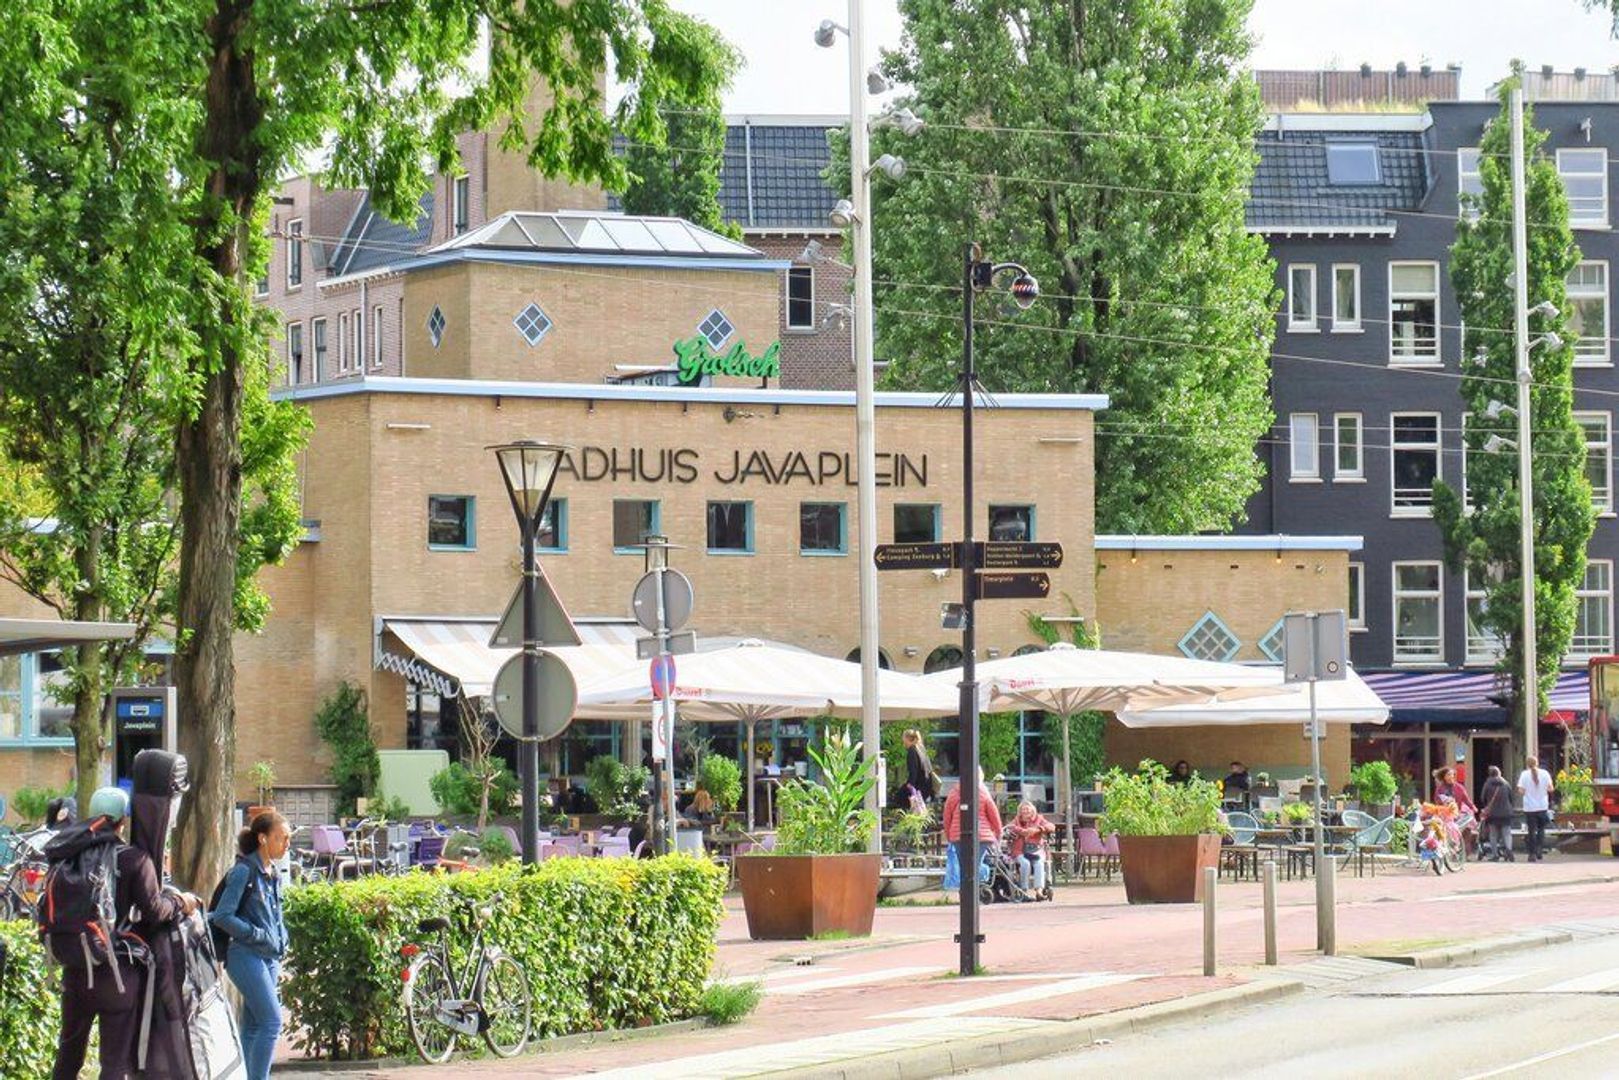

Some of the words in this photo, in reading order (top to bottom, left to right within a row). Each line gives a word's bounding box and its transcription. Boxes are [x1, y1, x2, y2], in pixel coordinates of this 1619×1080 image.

[673, 336, 781, 382] Grolsch
[557, 447, 699, 483] ADHUIS
[714, 450, 928, 487] JAVAPLEIN
